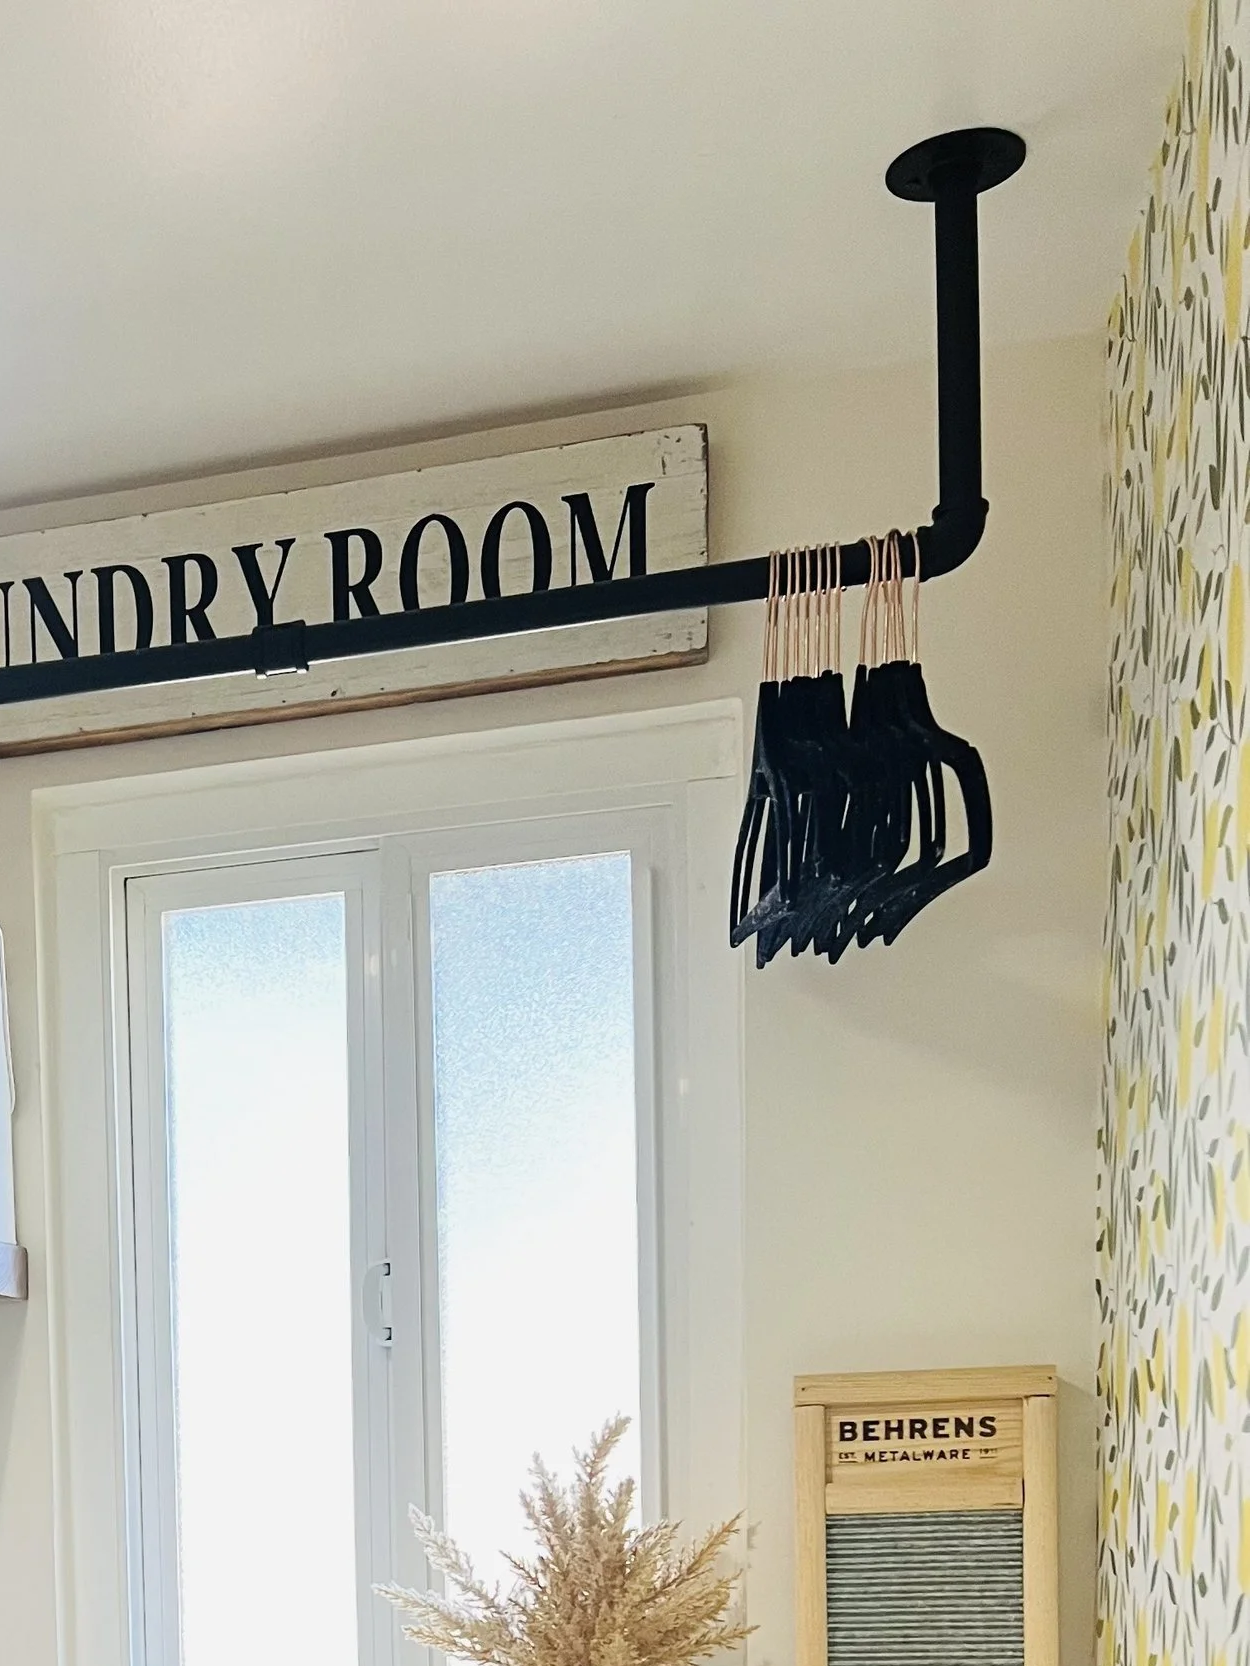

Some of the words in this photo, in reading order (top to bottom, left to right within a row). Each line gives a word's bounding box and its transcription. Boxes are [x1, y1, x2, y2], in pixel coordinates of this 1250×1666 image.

[324, 482, 655, 623] ROOM
[839, 1415, 998, 1442] BEHRENS
[839, 1451, 857, 1461] EST.
[864, 1448, 972, 1463] METALWARE
